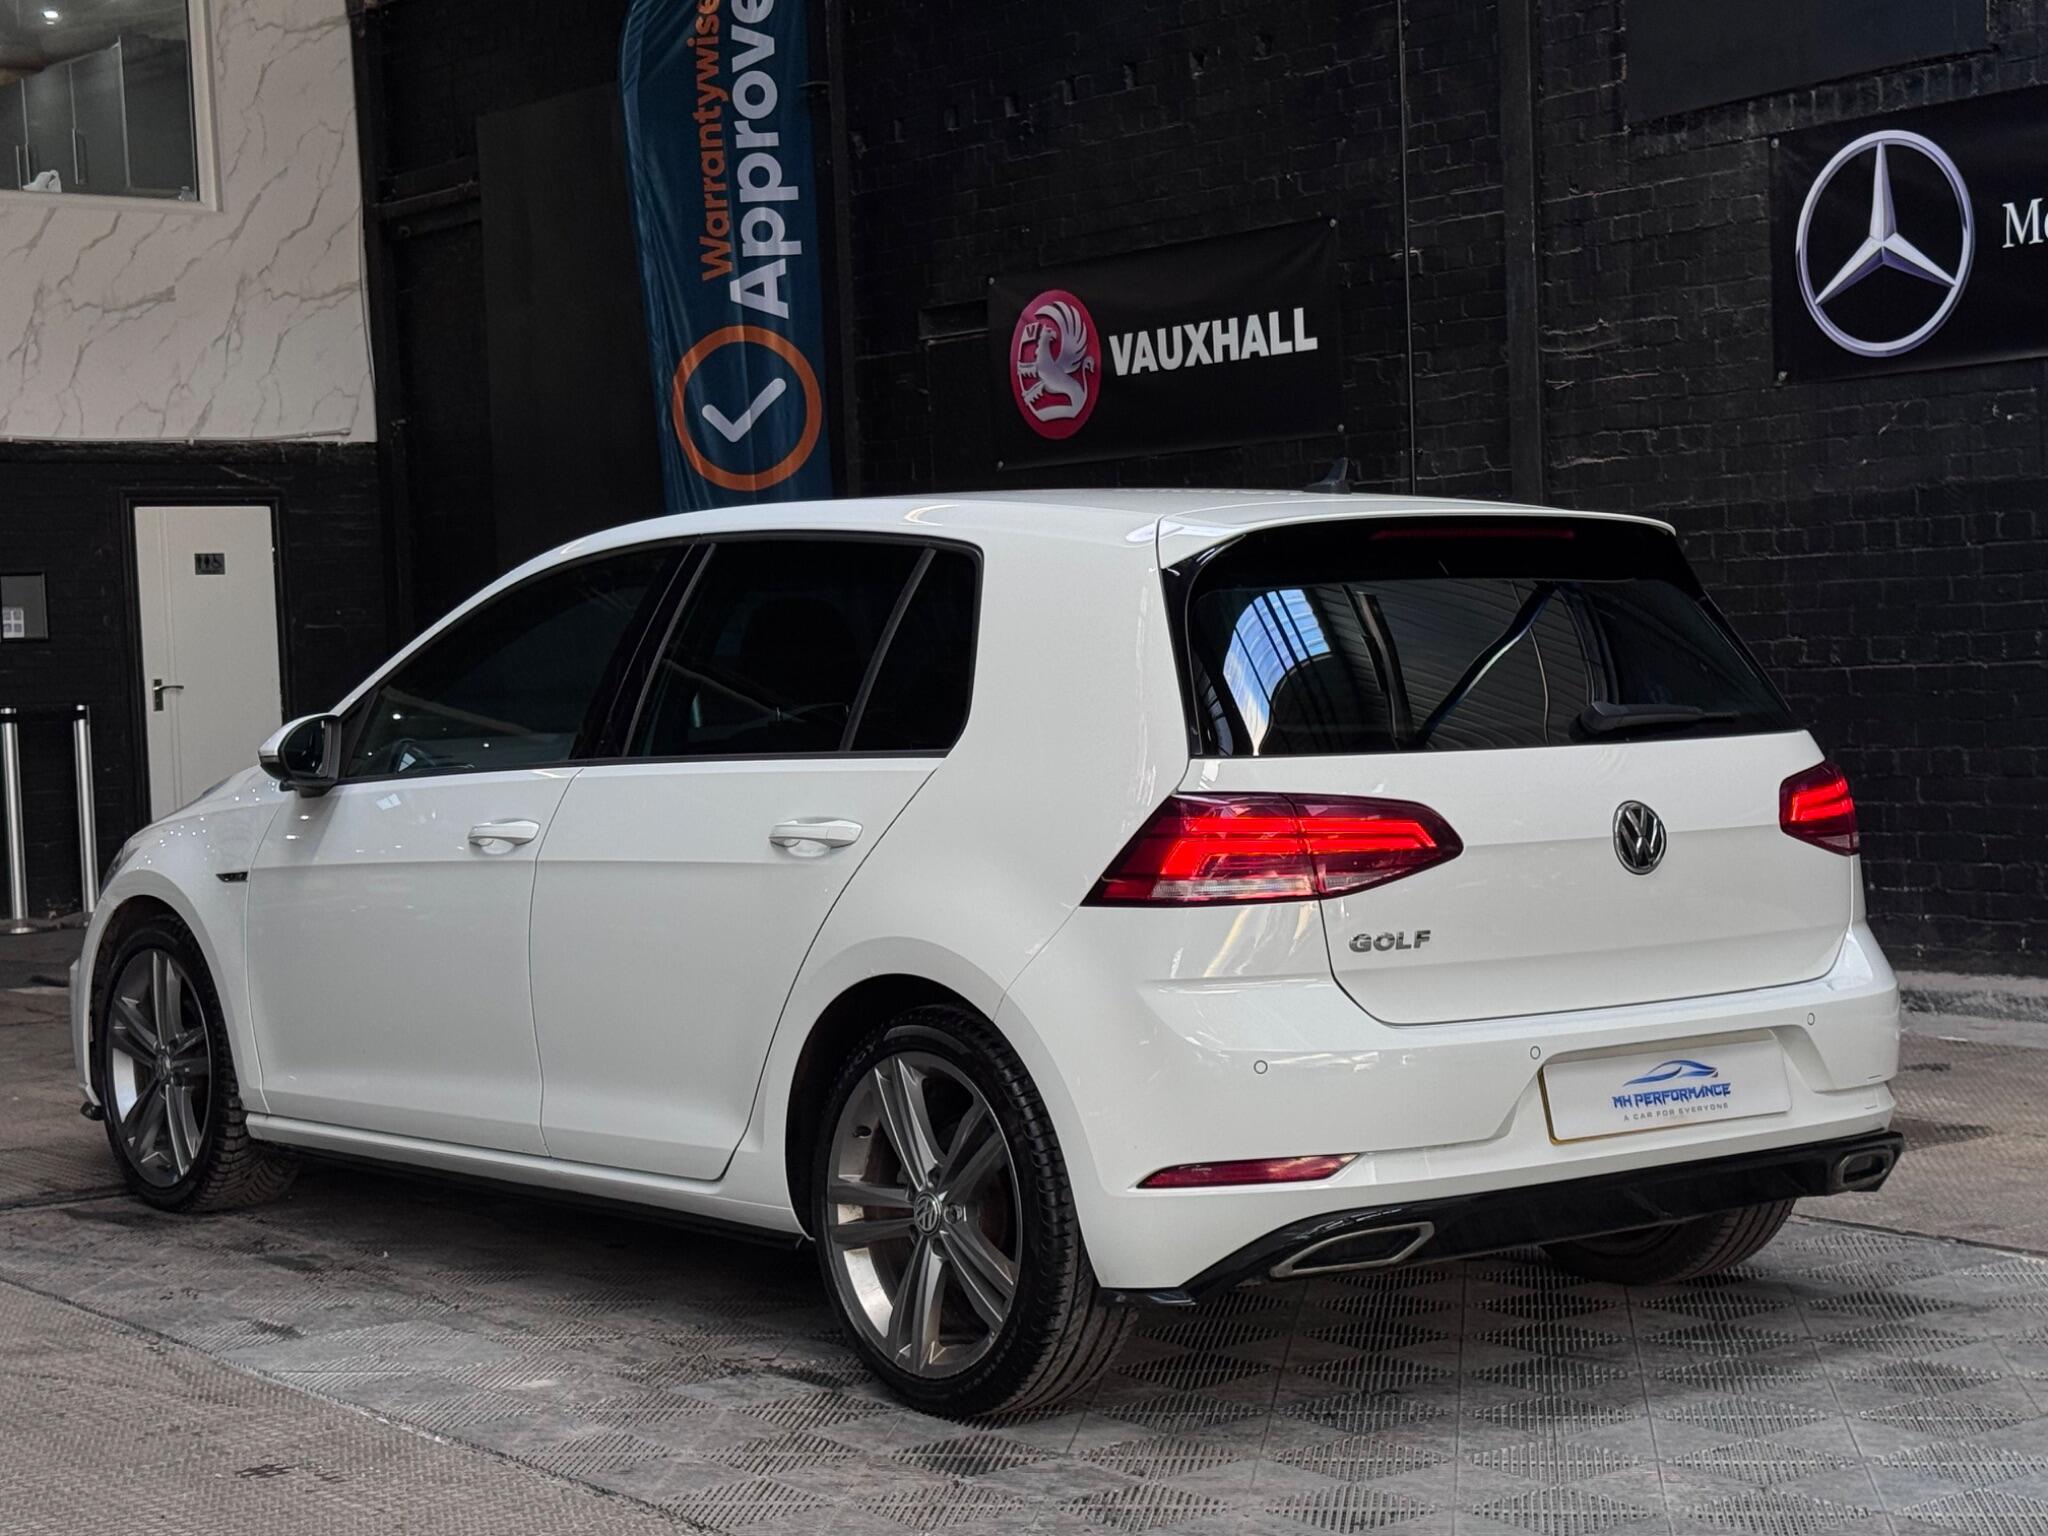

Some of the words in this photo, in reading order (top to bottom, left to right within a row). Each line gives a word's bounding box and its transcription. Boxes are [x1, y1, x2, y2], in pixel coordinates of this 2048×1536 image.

[687, 0, 733, 281] Warrantywise
[2001, 197, 2048, 249] M
[1108, 307, 1319, 376] VAUXHALL
[1349, 930, 1431, 953] GOLF
[1633, 1082, 1732, 1109] PERFORMANCE
[1633, 1111, 1653, 1121] CAR
[1656, 1109, 1676, 1118] FOR
[1678, 1102, 1729, 1115] EVERYONE
